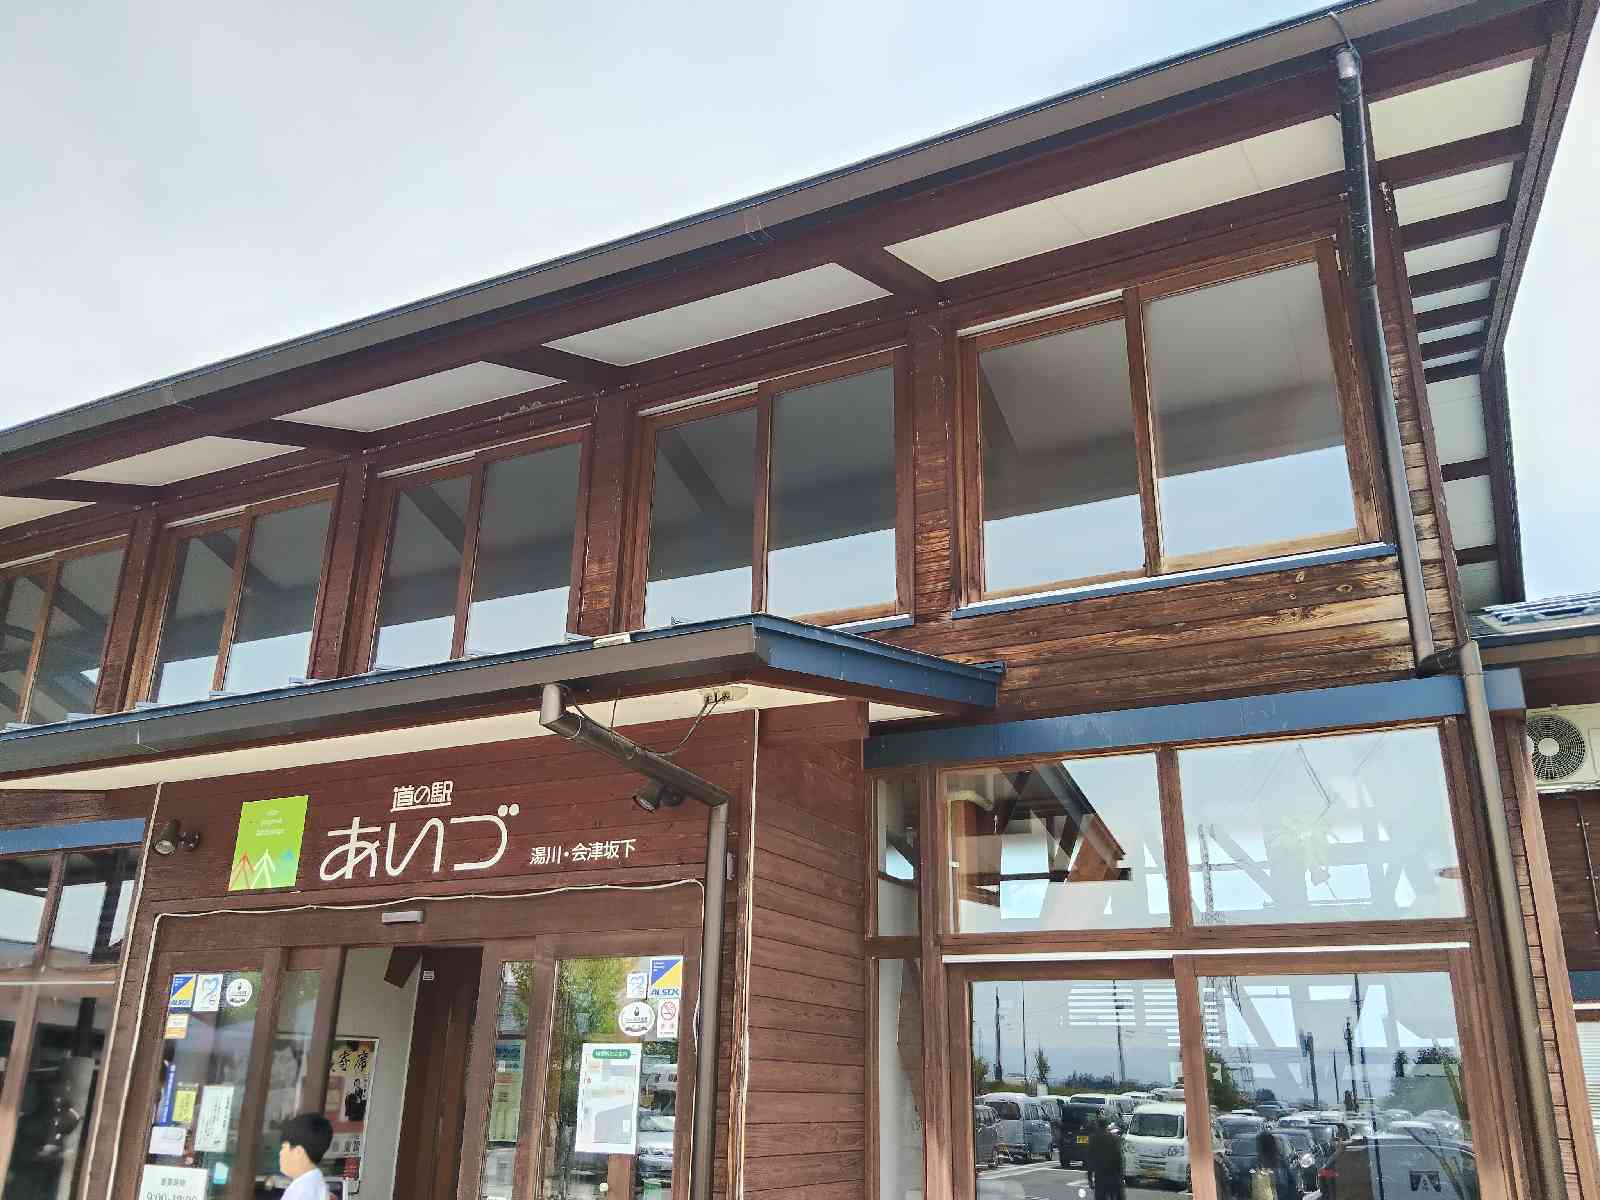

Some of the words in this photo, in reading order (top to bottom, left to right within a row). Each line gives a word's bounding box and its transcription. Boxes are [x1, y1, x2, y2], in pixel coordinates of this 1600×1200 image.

[391, 780, 453, 812] 道の駅
[320, 803, 520, 881] あいづ
[530, 839, 637, 865] 湯川・会津坂下
